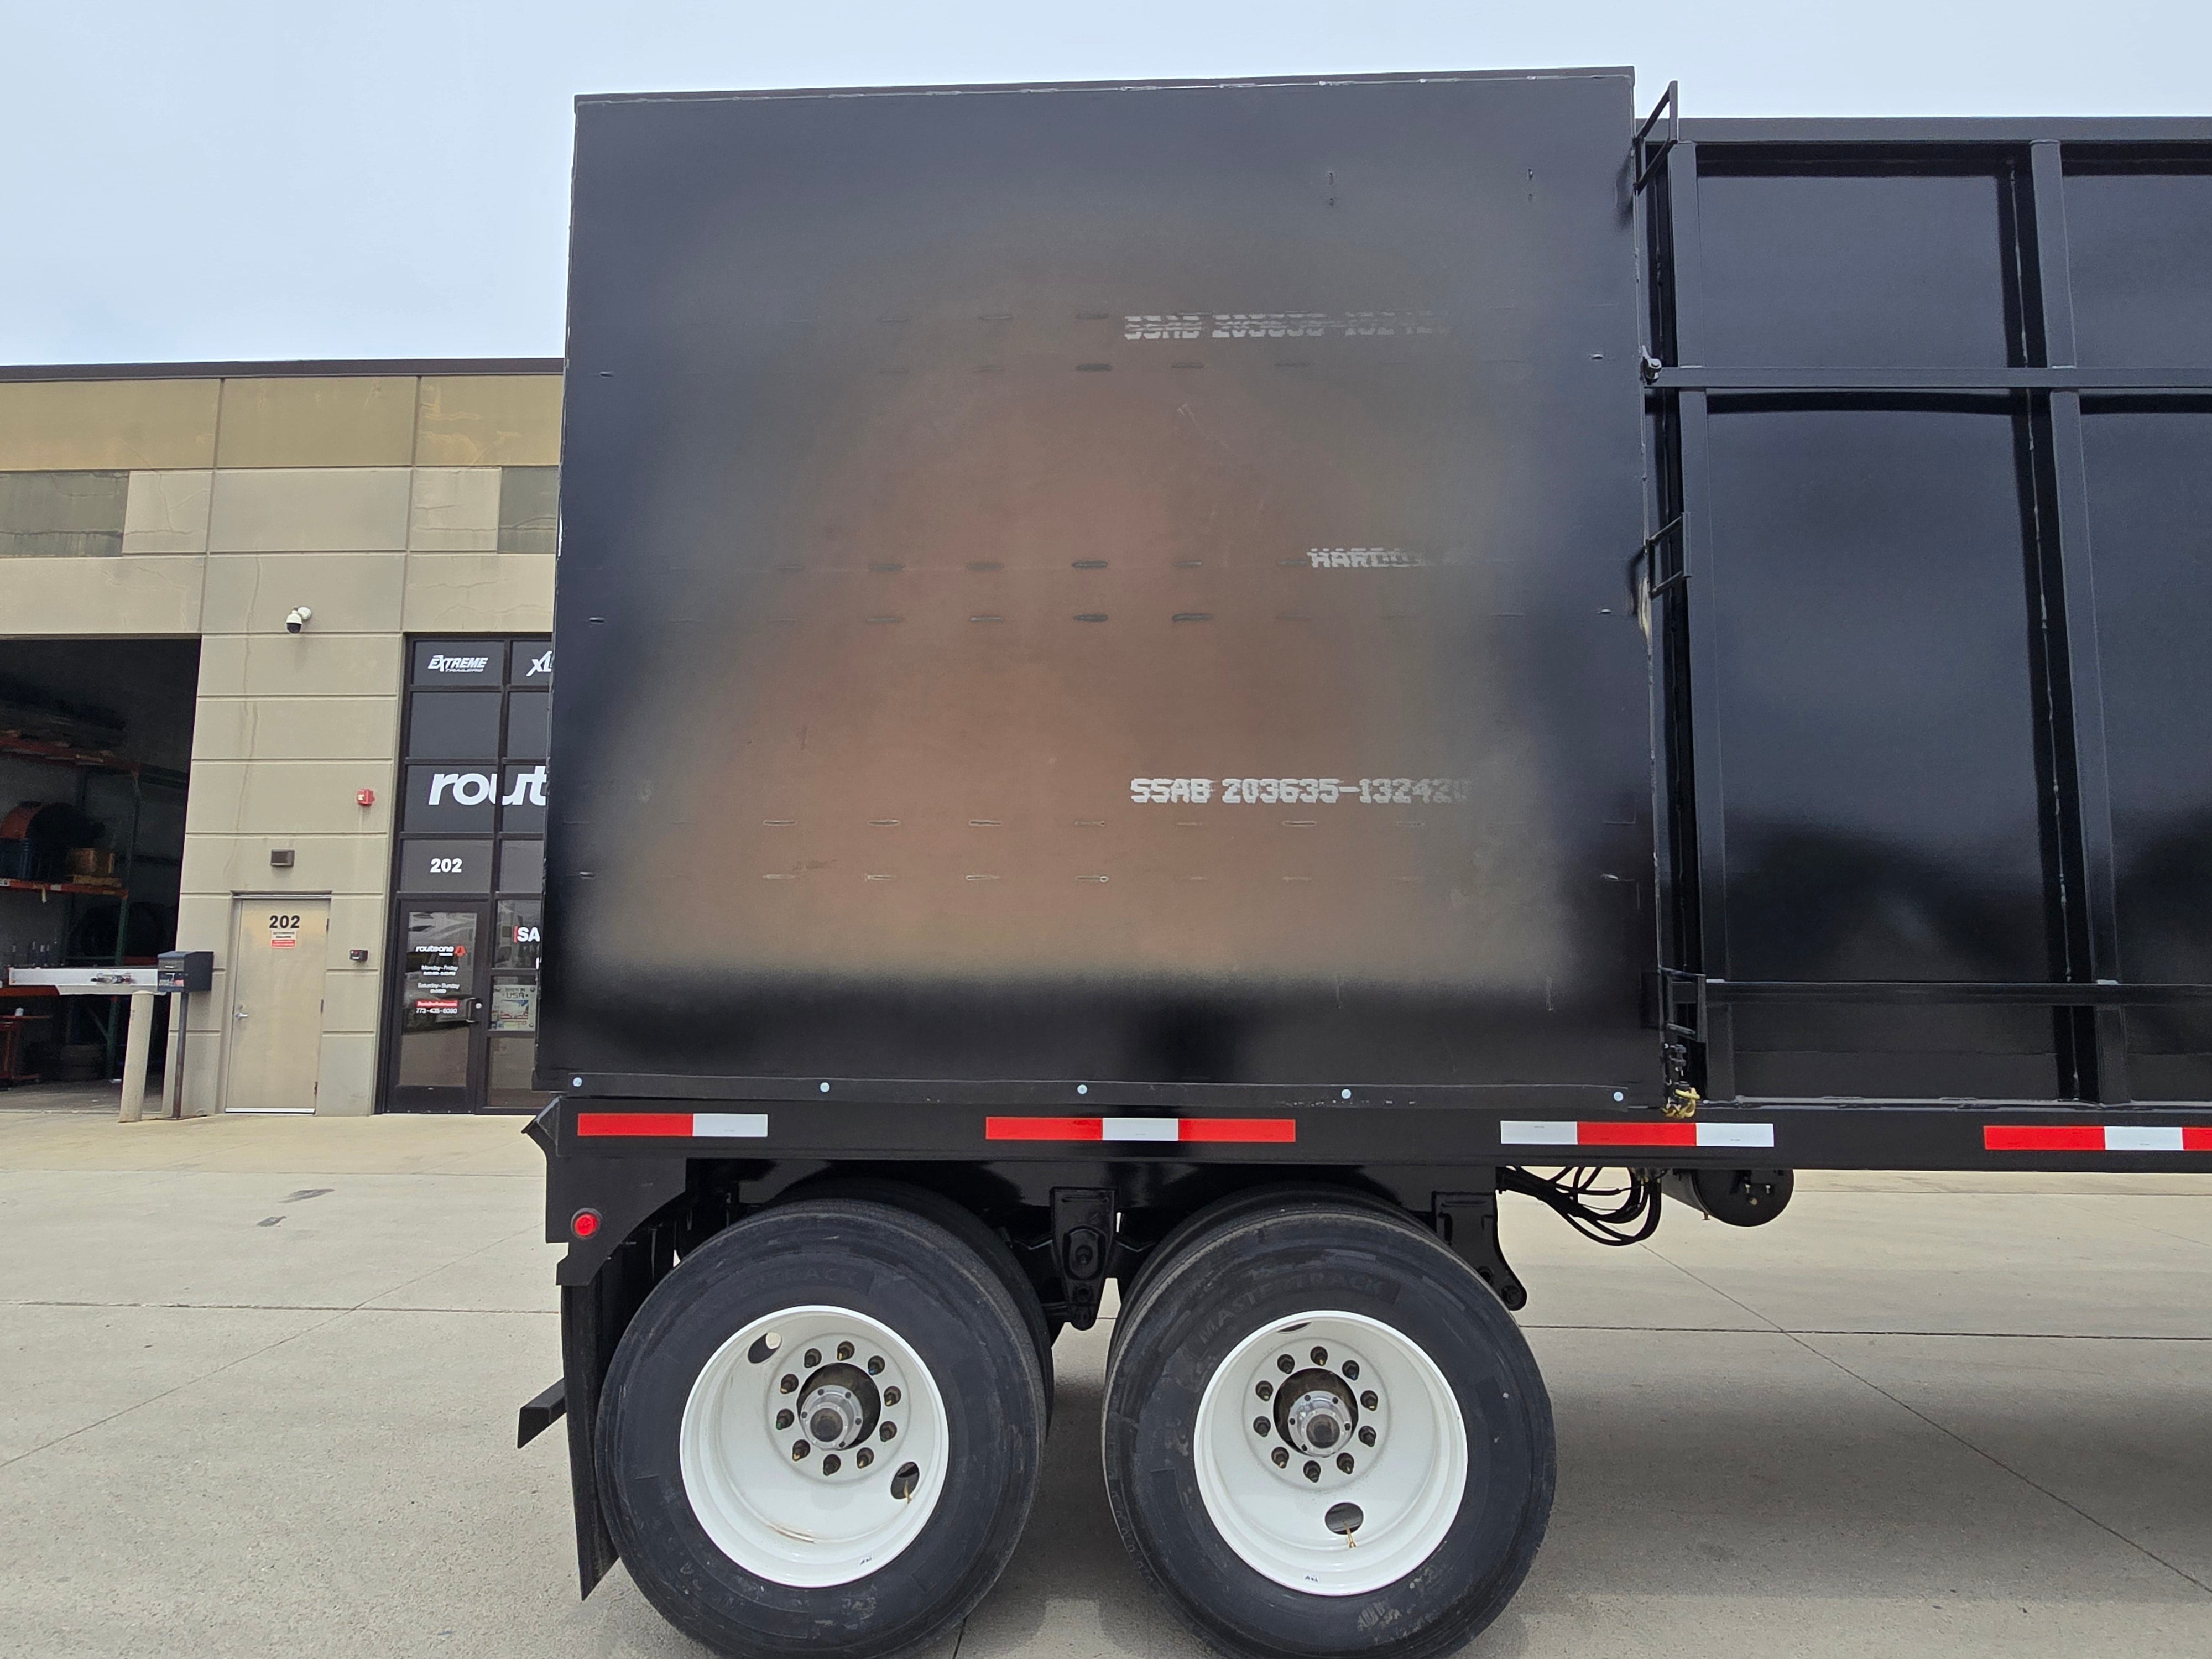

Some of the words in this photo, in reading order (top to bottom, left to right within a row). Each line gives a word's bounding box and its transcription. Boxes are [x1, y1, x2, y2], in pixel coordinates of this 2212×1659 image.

[427, 655, 488, 672] EXTREME
[1130, 778, 1212, 803] SSAB
[430, 858, 463, 873] 202
[269, 915, 300, 928] 202
